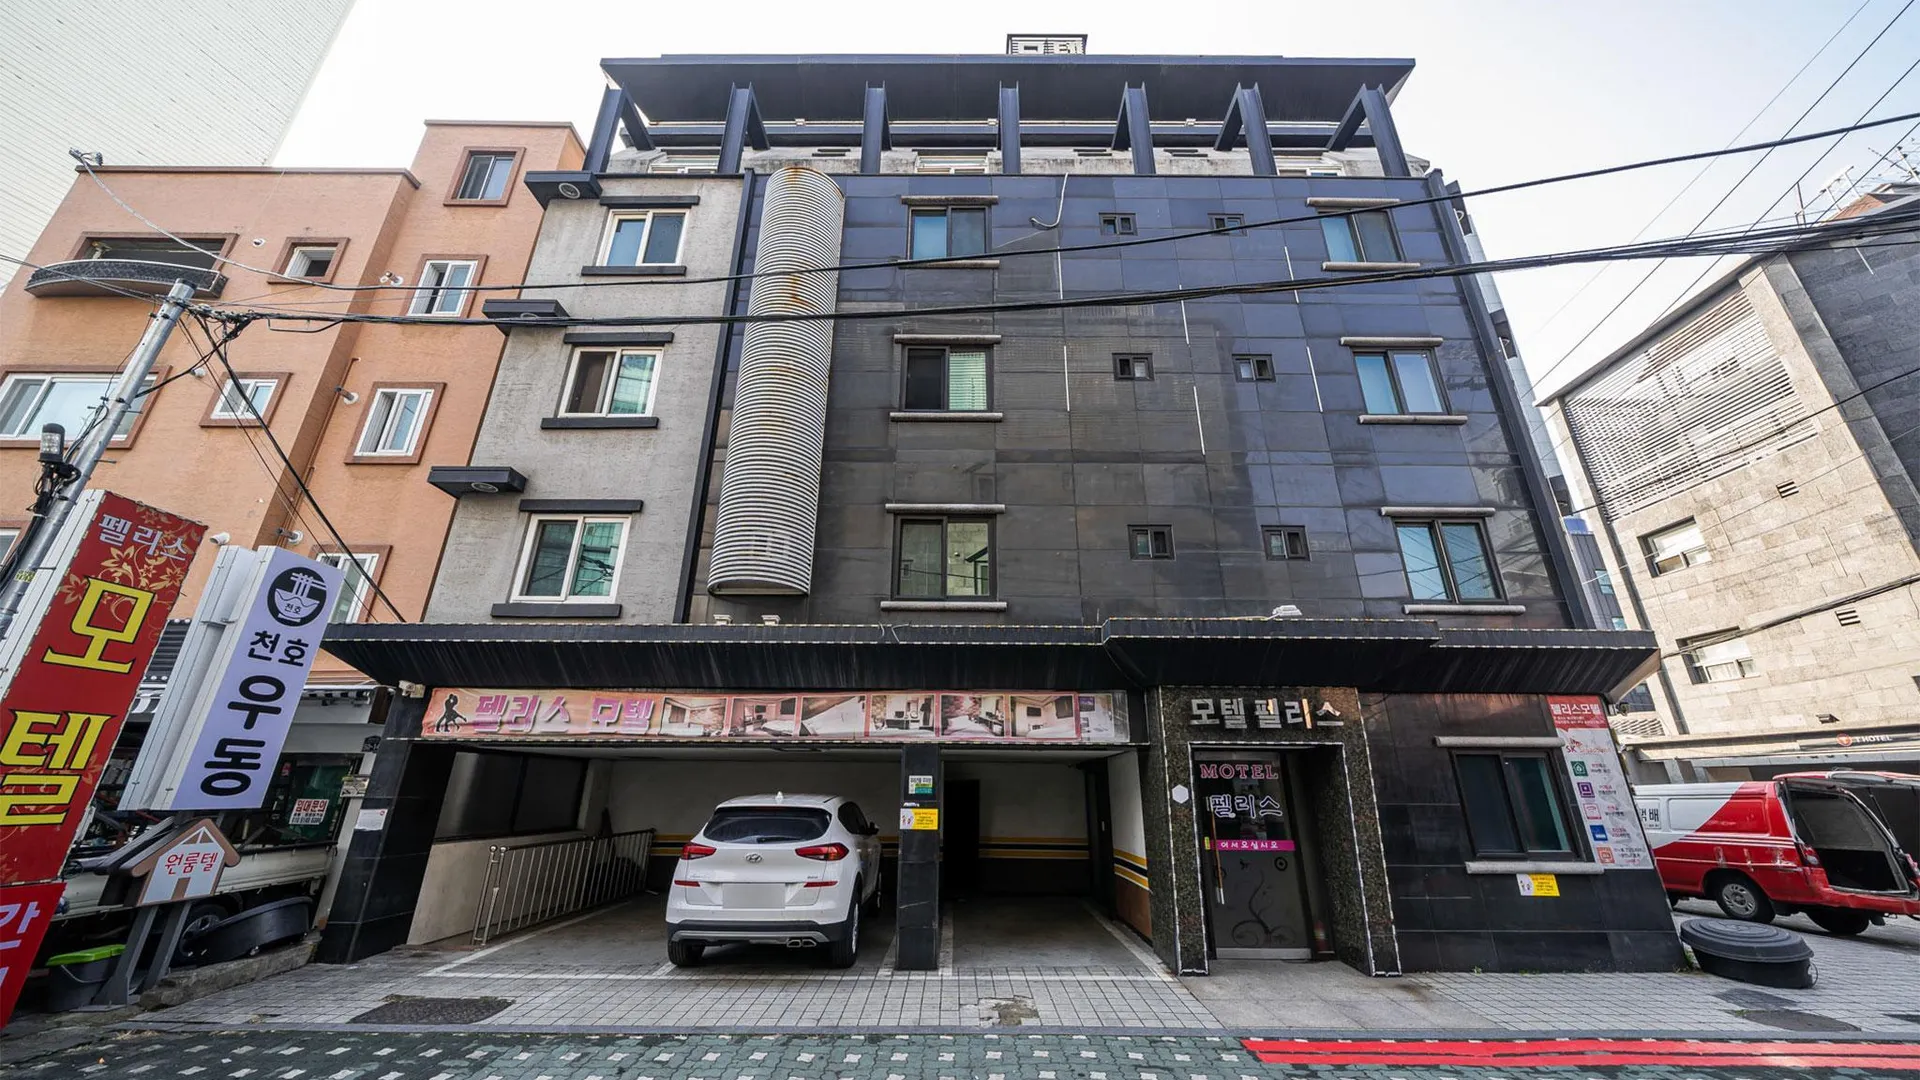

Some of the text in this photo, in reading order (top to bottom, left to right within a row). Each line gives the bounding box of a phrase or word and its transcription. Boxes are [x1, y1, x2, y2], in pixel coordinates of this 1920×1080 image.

[97, 513, 188, 562] 펠리스
[247, 629, 309, 668] 천호
[0, 574, 156, 826] 모텔
[473, 694, 657, 735] 펠리스 모텔
[200, 674, 286, 797] 우동
[1200, 763, 1279, 780] MOTEL
[295, 799, 328, 813] 임대문의
[1210, 793, 1283, 819] 펠리스
[1220, 840, 1280, 850] 어서오십시오
[165, 852, 218, 876] 원룸텔
